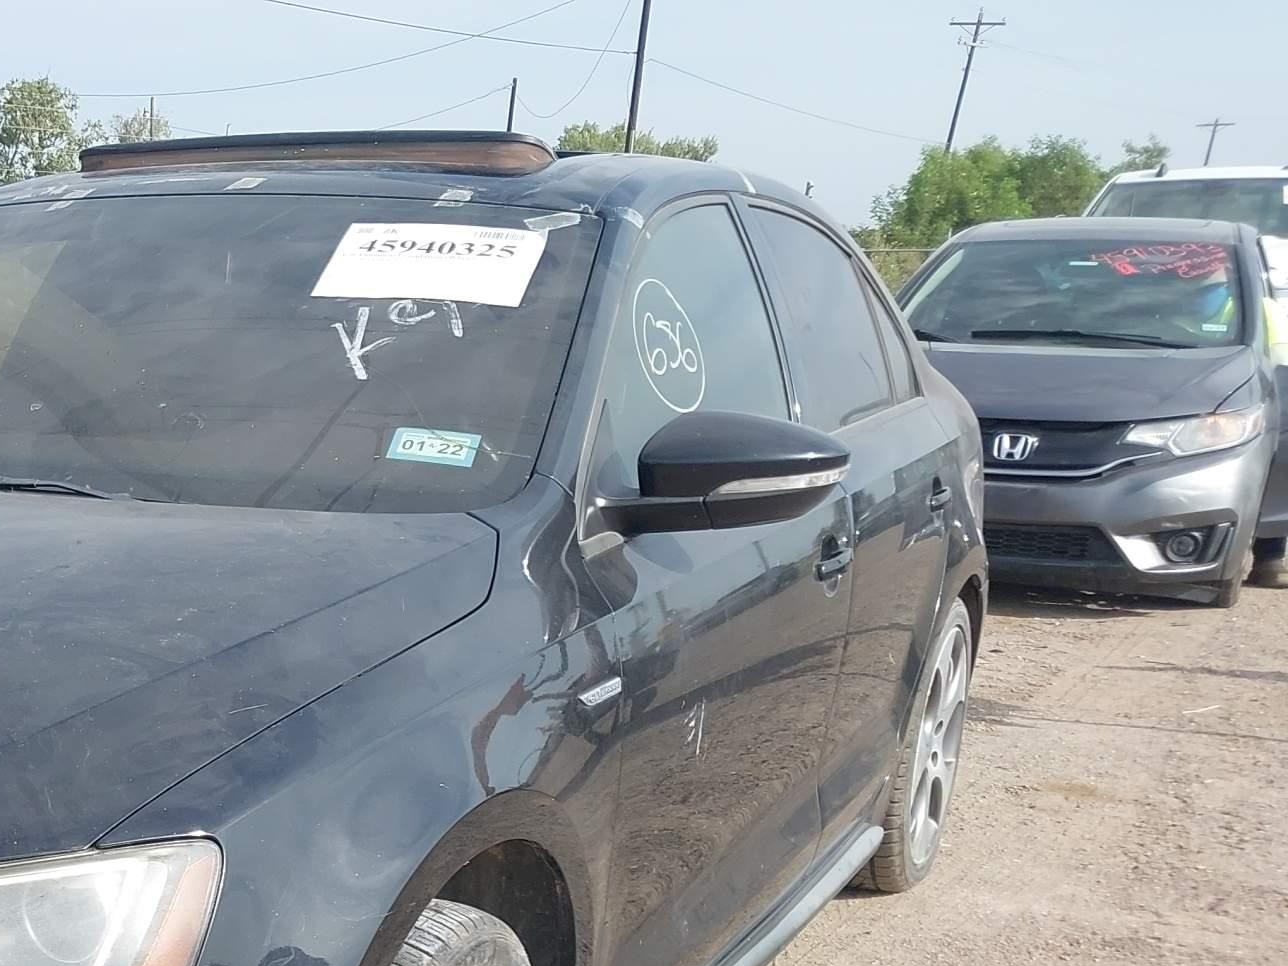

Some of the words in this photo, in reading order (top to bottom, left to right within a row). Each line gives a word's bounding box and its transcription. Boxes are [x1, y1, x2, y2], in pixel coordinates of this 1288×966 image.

[359, 238, 518, 259] 45940325
[401, 439, 426, 452] 01
[437, 443, 465, 457] 22
